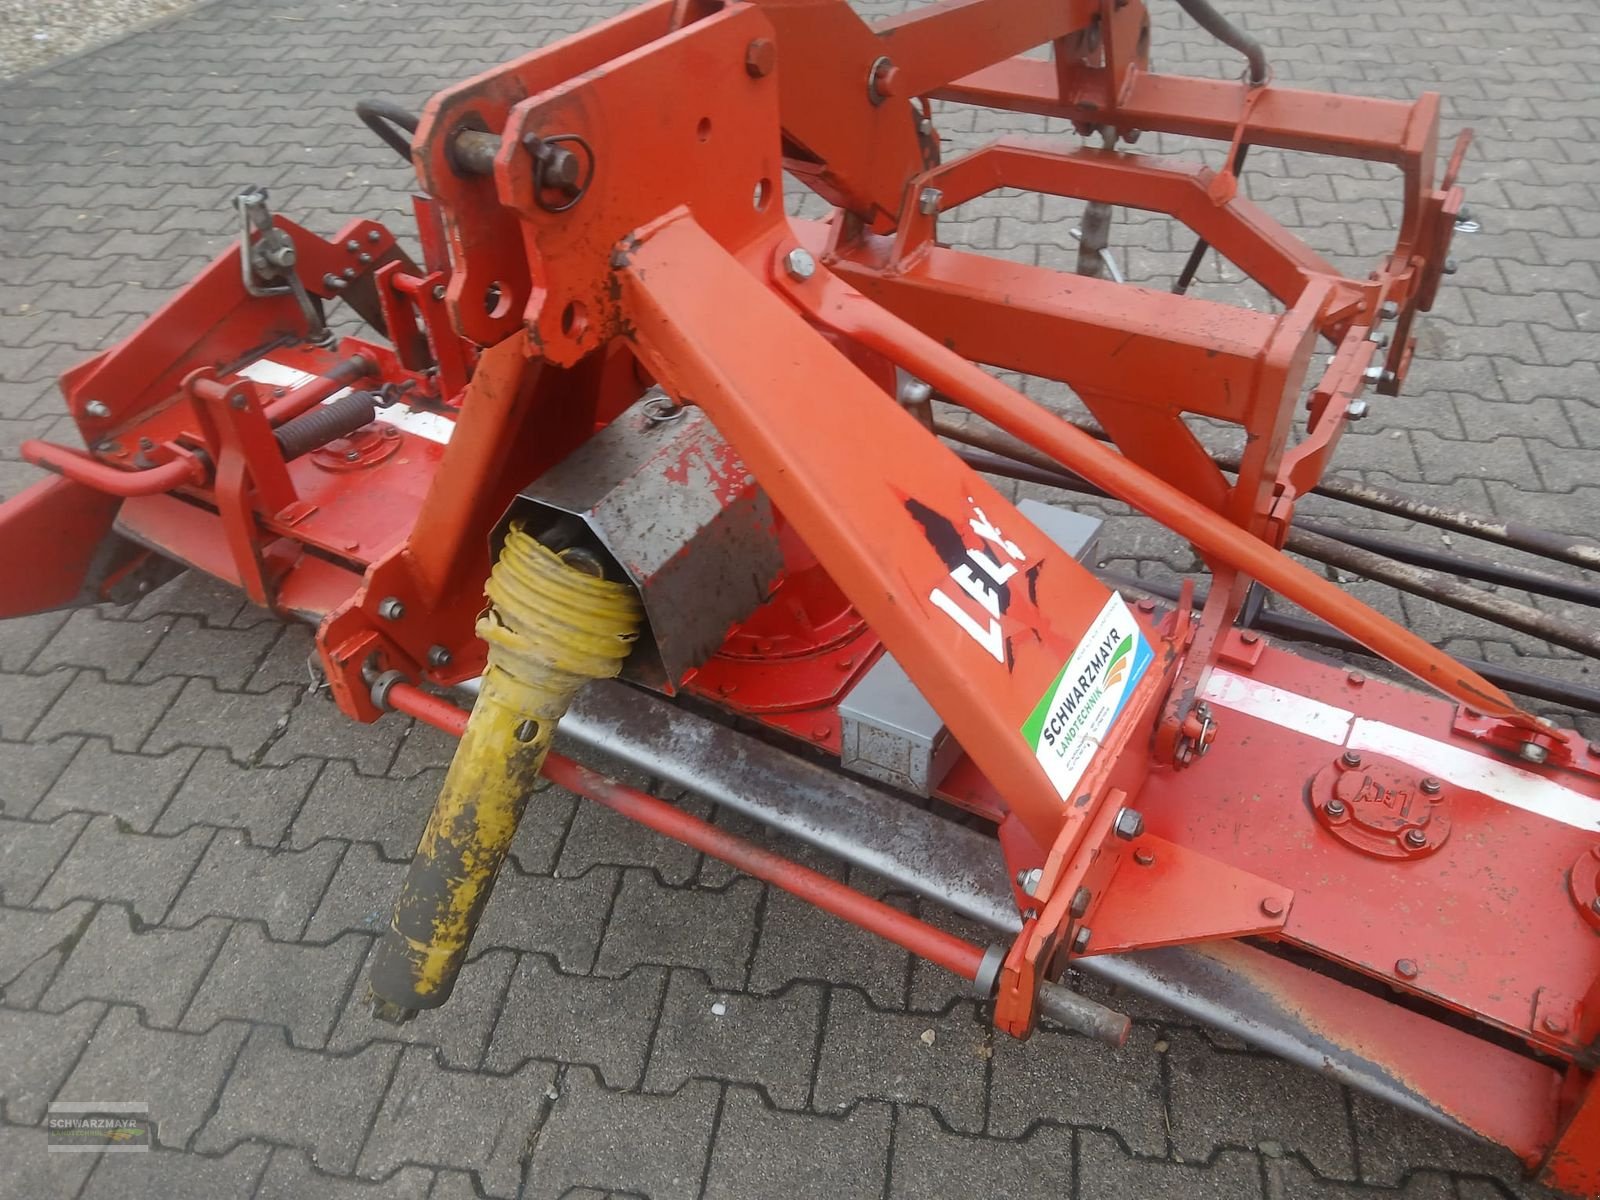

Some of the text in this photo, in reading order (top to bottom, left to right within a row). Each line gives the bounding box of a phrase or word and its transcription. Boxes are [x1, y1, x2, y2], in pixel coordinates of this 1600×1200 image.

[929, 506, 1026, 663] LELY
[1043, 627, 1121, 747] SCHWARZMAYR
[1055, 686, 1103, 758] LANDTECHNIK
